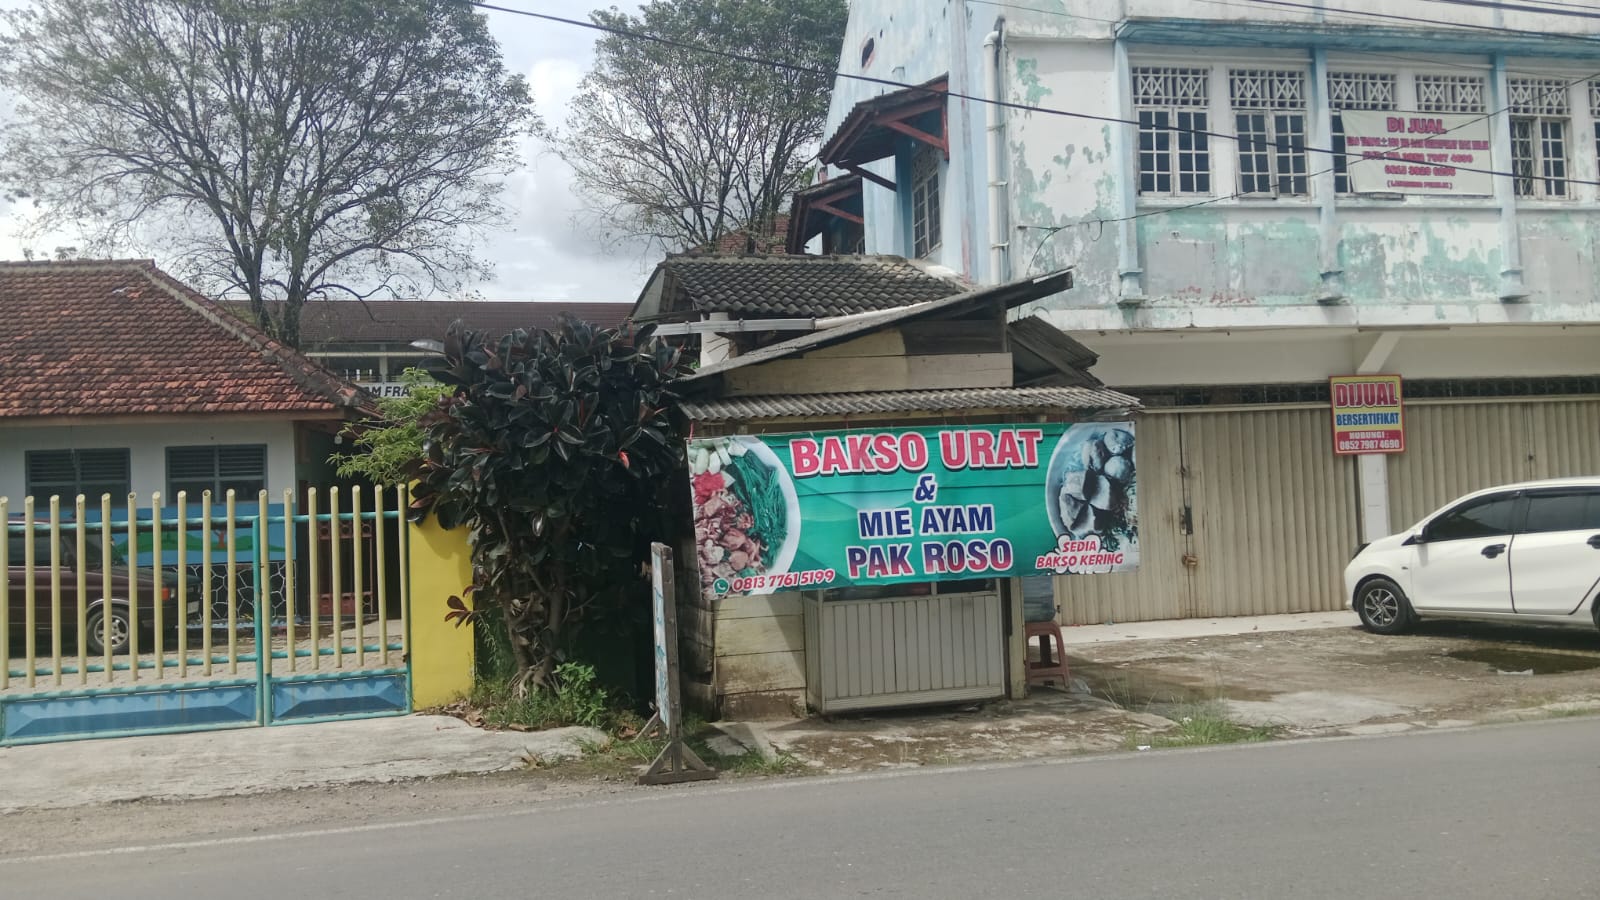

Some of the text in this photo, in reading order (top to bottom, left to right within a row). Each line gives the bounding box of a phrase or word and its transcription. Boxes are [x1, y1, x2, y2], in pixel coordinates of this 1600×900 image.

[1386, 117, 1446, 134] DI JUAL
[1334, 382, 1398, 408] DIJUAL
[1336, 412, 1399, 426] BERSERTIFIKAT
[789, 428, 1043, 476] BAKSO URAT
[914, 473, 937, 502] &
[857, 504, 995, 539] MIE AYAM
[846, 537, 1013, 579] PAK ROSO
[1062, 539, 1098, 553] SEDIA
[1036, 552, 1124, 568] BAKSO KERING
[732, 569, 836, 592] 0813 7761 5199
